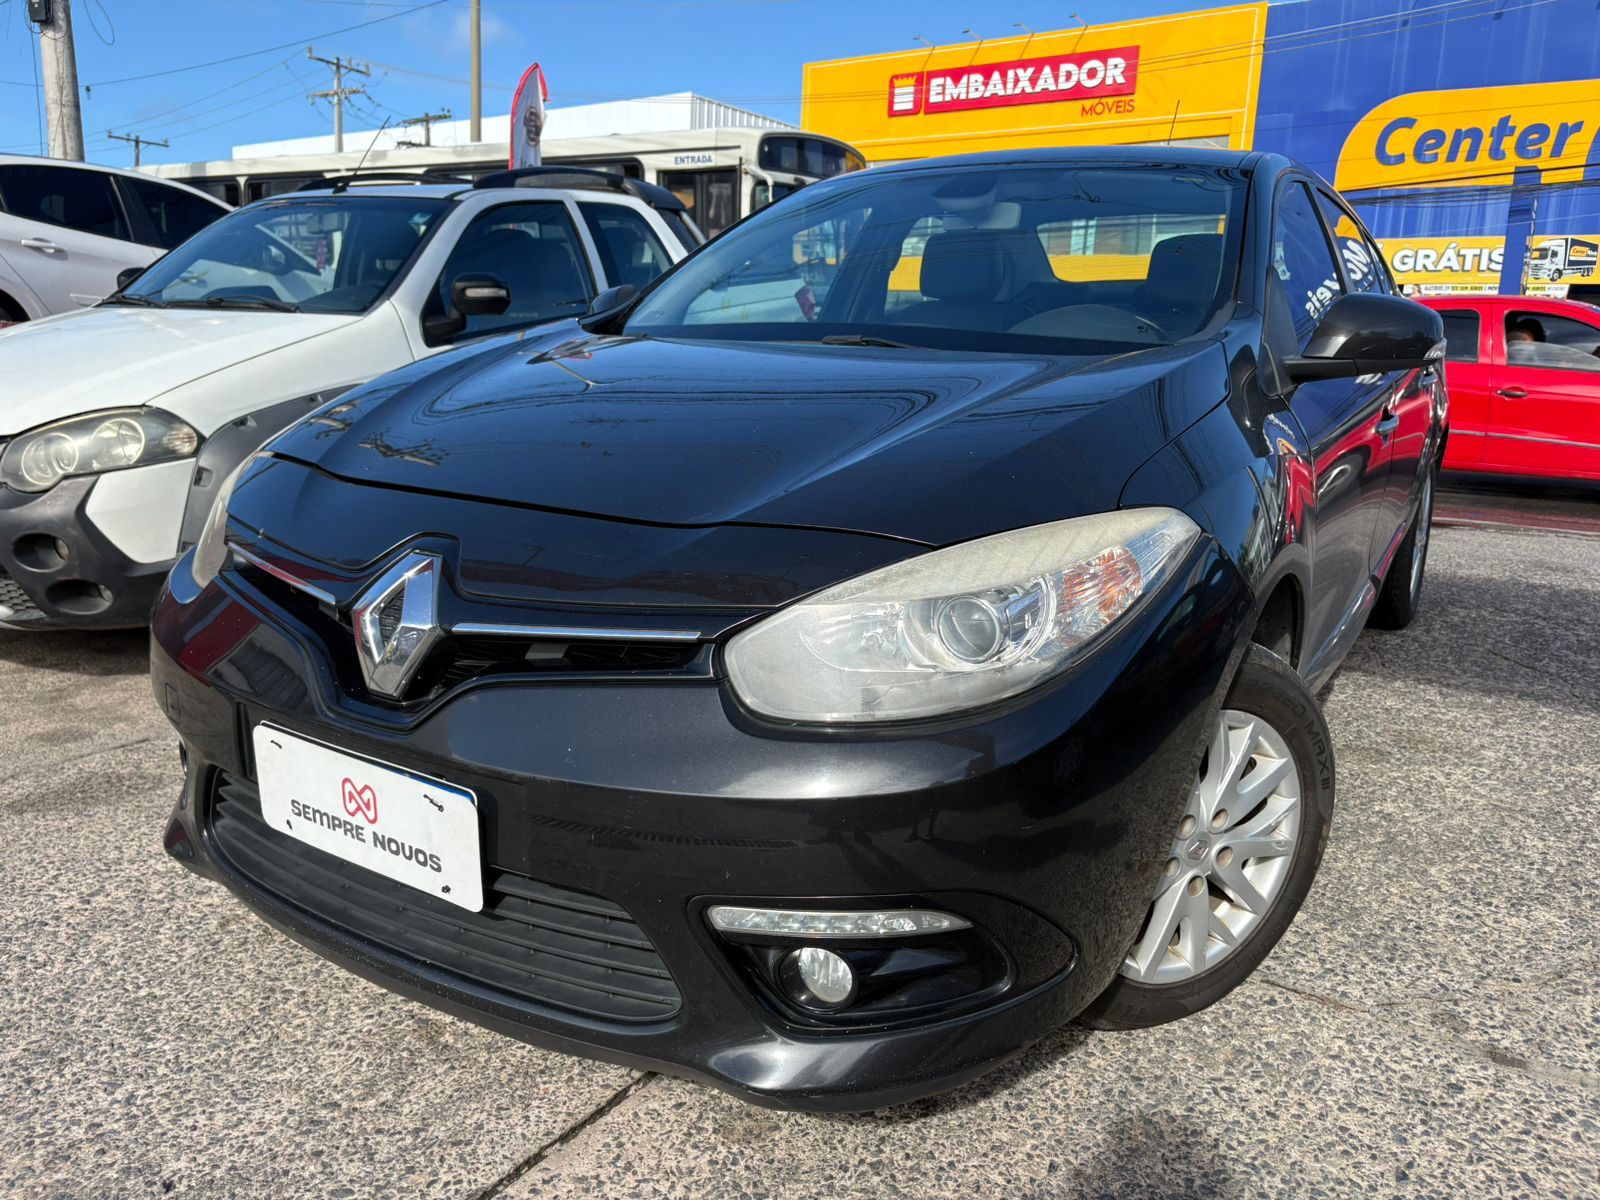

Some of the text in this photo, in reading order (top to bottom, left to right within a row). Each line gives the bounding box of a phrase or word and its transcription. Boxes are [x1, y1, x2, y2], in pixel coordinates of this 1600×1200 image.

[929, 57, 1127, 104] EMBAIXADOR
[1080, 98, 1136, 118] MÓVEIS
[1375, 114, 1584, 166] Center
[674, 154, 713, 166] ENTRADA
[1392, 241, 1504, 273] GRÁTIS
[290, 799, 367, 844] SEMPRE
